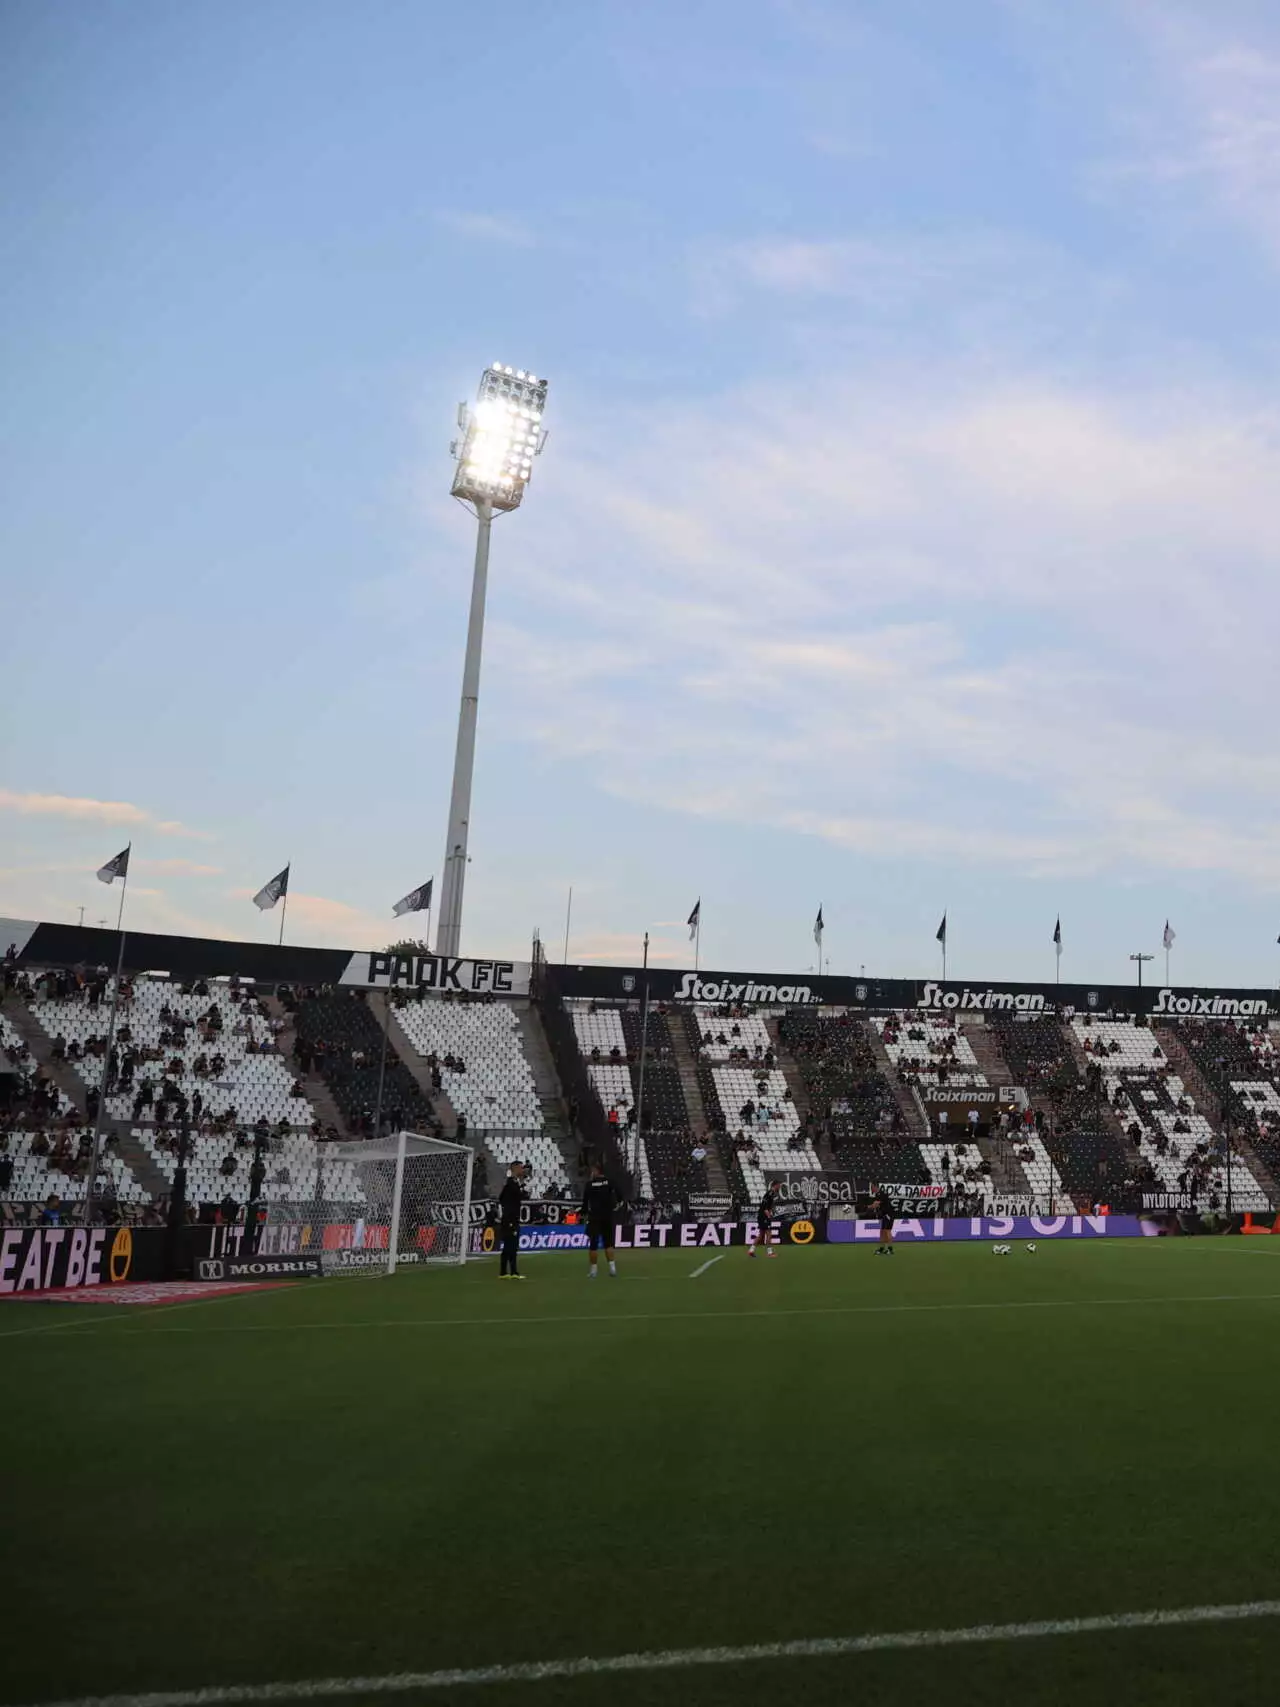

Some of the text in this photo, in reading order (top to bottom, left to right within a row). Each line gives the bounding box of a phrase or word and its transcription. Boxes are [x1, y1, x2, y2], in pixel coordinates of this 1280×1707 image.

[368, 952, 513, 990] PAOK FC
[674, 973, 811, 1003] Stoiximan
[917, 982, 1044, 1010] Stoiximan
[1152, 989, 1268, 1015] Stoiximan
[924, 1087, 996, 1102] Stoiximan
[1142, 1193, 1192, 1209] MYLOTOPOS
[614, 1223, 672, 1248] LET
[680, 1223, 737, 1247] EAT
[0, 1228, 106, 1293] EAT BE
[229, 1260, 319, 1275] MORRIS
